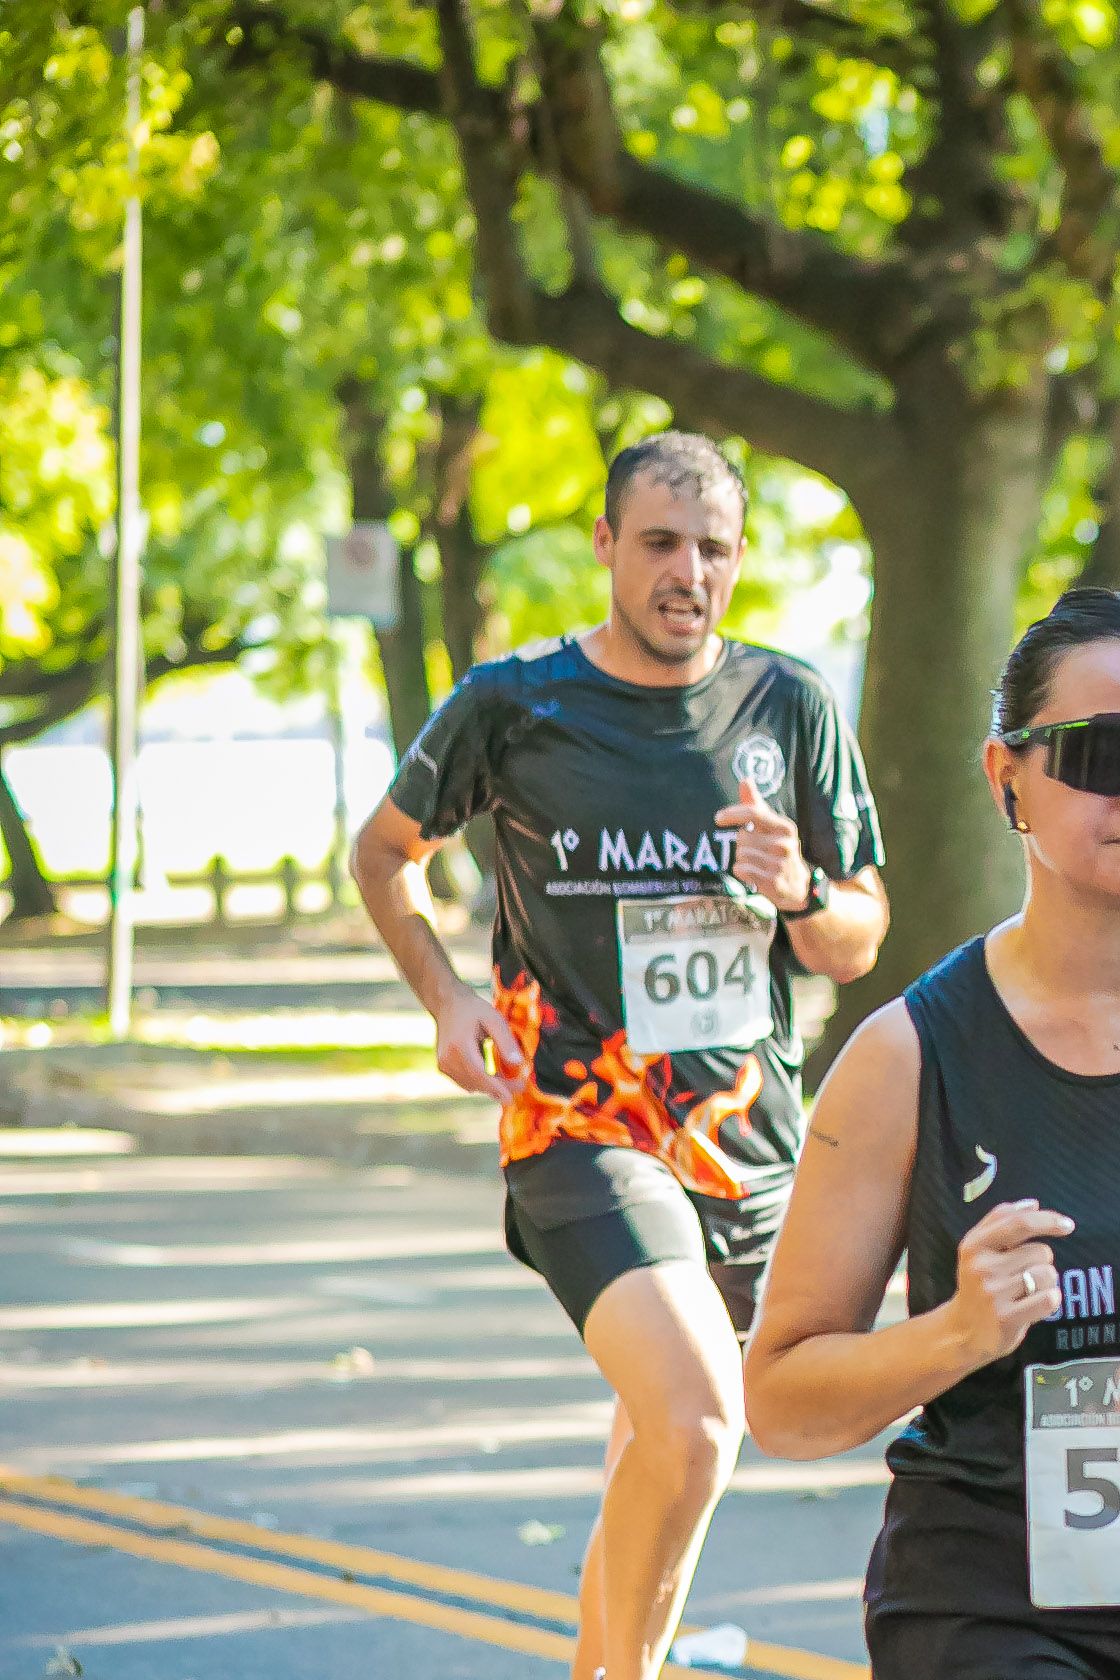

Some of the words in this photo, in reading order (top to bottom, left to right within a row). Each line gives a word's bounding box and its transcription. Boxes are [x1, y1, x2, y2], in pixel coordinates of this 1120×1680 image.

[598, 827, 738, 872] MARAT
[644, 945, 756, 1004] 604
[1046, 1265, 1116, 1321] AN
